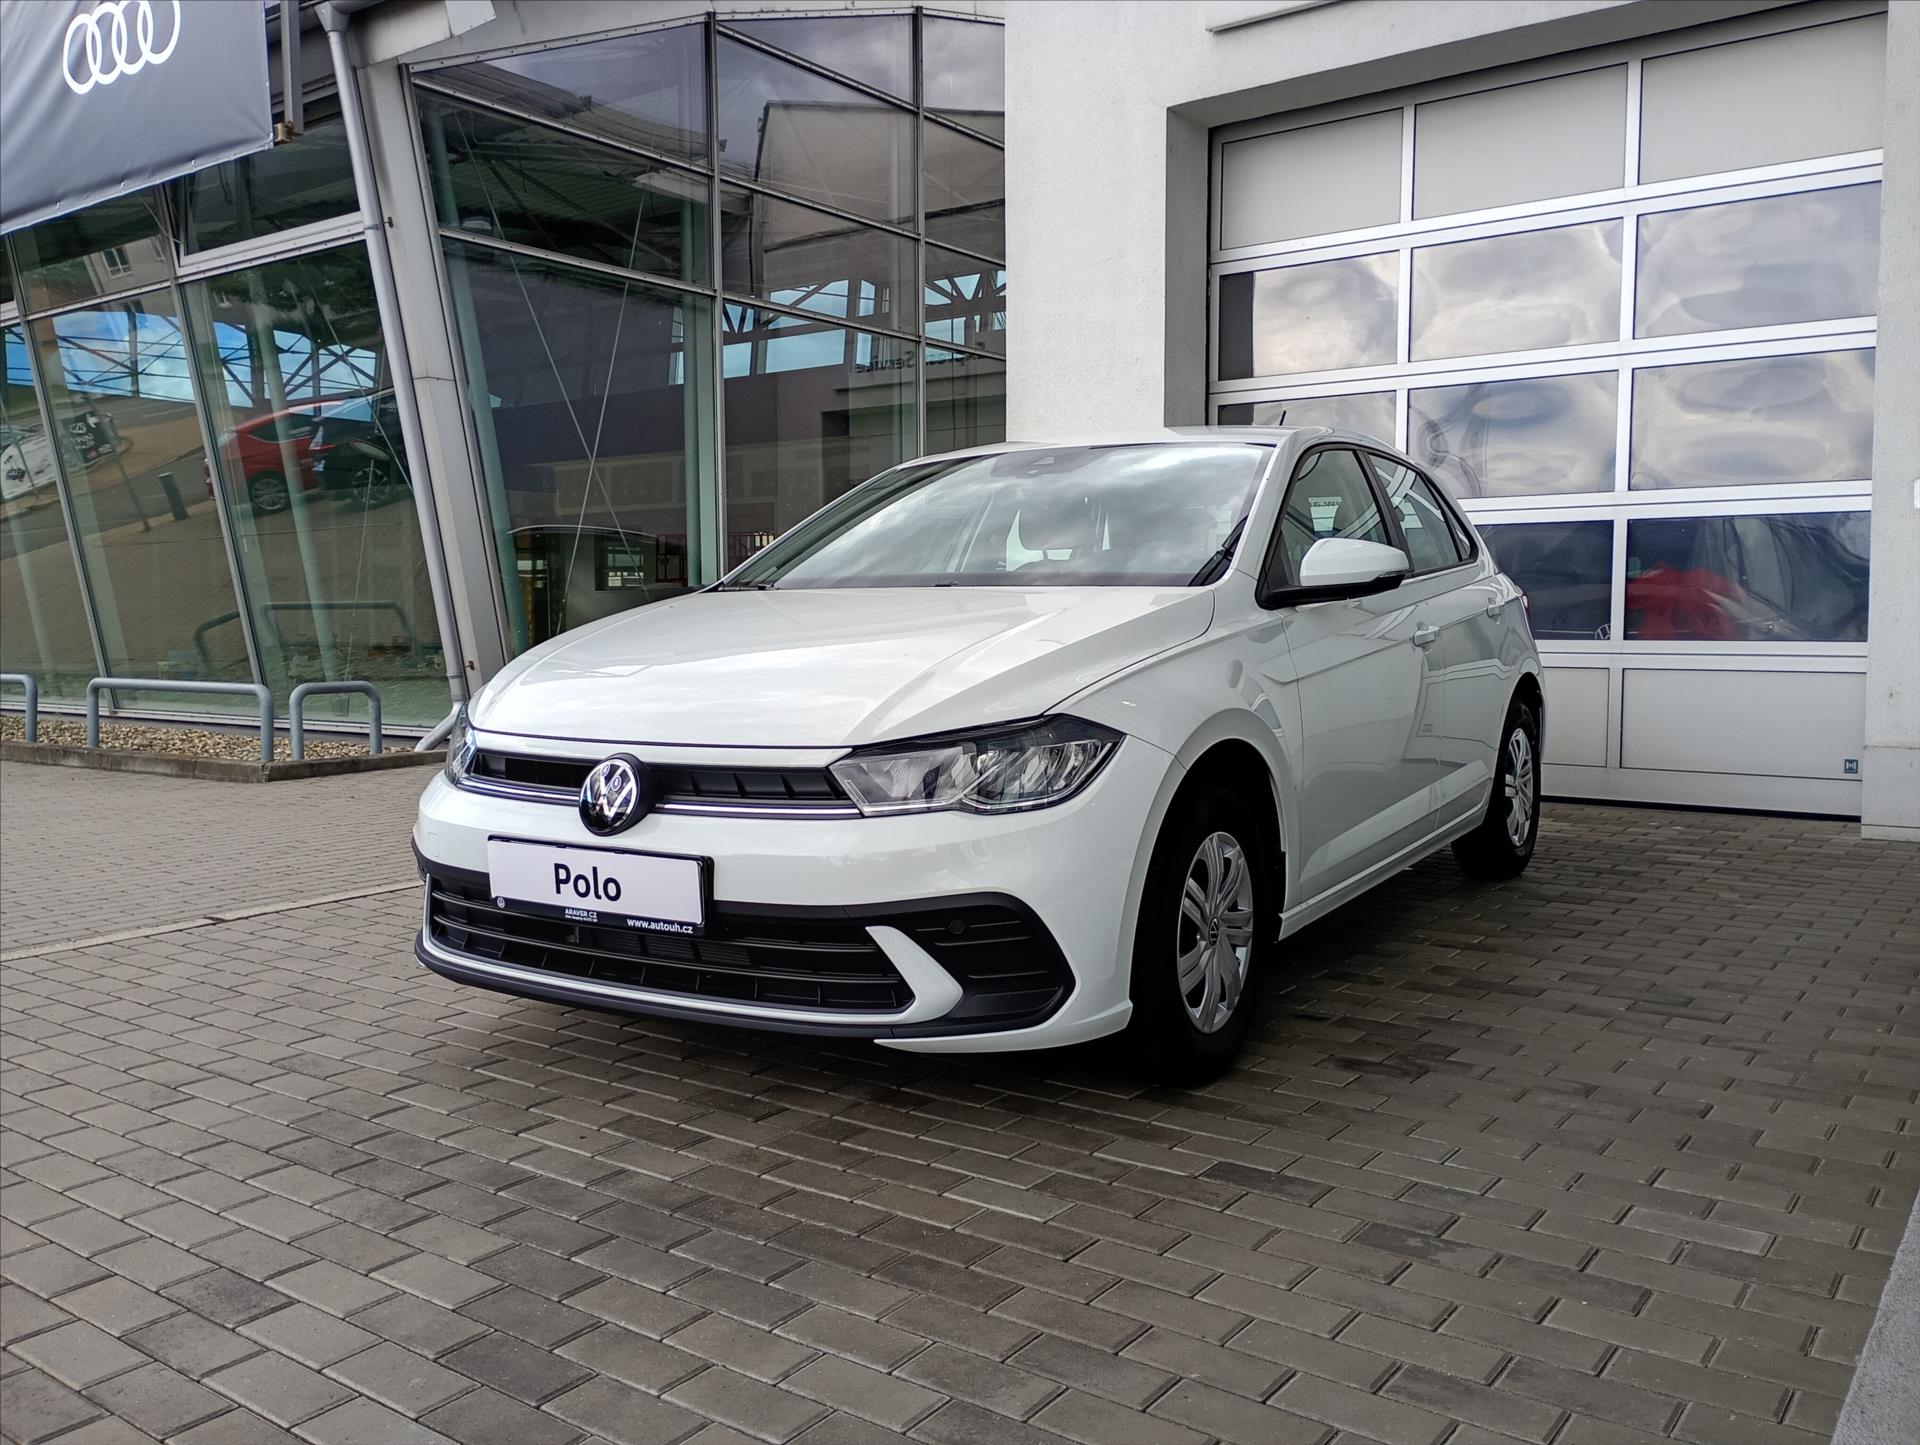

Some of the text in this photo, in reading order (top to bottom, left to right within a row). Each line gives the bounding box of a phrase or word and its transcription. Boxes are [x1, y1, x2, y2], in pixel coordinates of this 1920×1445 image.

[554, 863, 622, 902] Polo
[564, 908, 588, 917] ARAVER
[588, 911, 598, 919] CZ
[626, 918, 694, 934] www.autouh.cz
